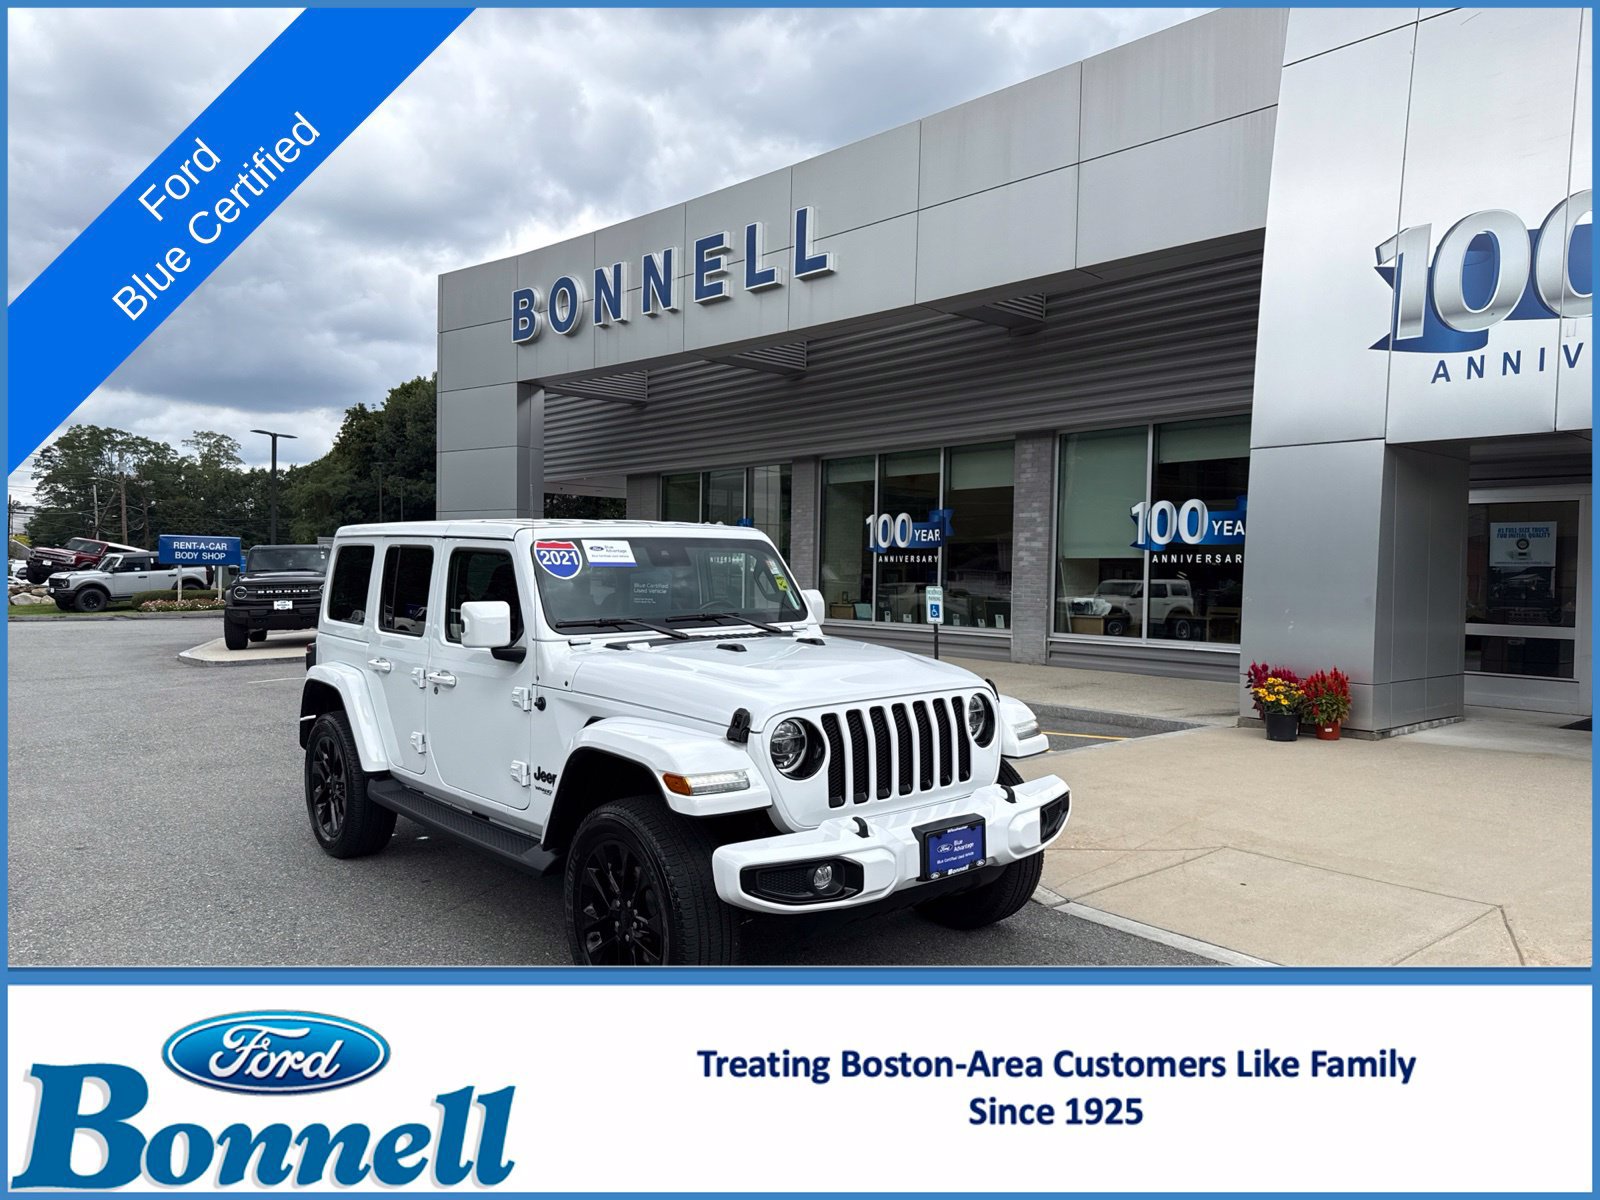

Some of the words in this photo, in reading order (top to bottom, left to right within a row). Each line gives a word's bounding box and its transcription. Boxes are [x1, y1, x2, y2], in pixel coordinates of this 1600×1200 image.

[511, 206, 833, 343] BONNELL
[1430, 342, 1584, 384] ANNIV
[1131, 499, 1209, 545] 100
[866, 512, 913, 548] 100
[914, 529, 941, 542] YEAR
[173, 541, 228, 551] RENT-A-CAR
[175, 551, 198, 559] BODY
[202, 552, 226, 560] SHOP
[540, 550, 579, 566] 2021
[878, 555, 939, 563] ANNIVERSARY
[1151, 554, 1243, 564] ANNIVERSAR
[534, 766, 557, 787] Jeep
[953, 842, 974, 852] Advantage
[947, 864, 969, 875] Bonnell
